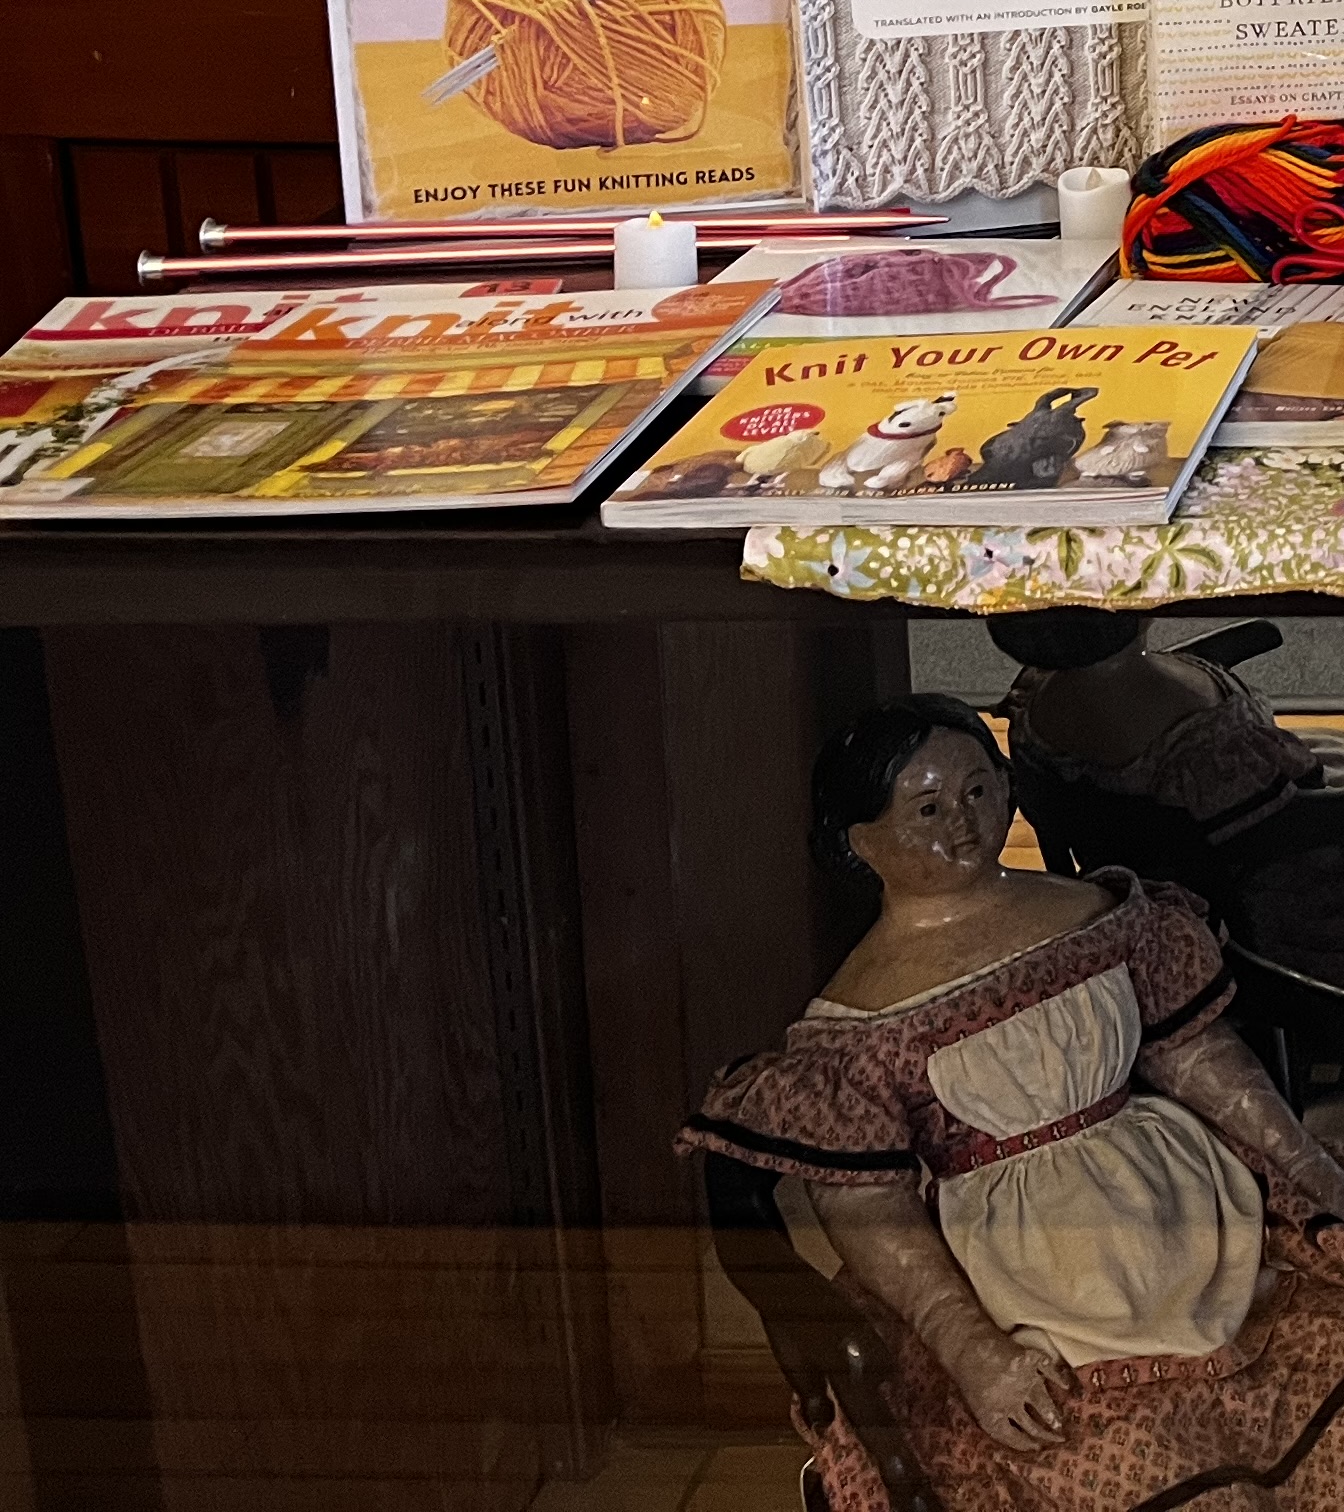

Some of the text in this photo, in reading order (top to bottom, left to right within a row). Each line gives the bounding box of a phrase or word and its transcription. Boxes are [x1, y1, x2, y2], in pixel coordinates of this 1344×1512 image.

[874, 15, 943, 27] TRANSLATED
[945, 13, 974, 23] WITH
[976, 12, 991, 20] AN
[993, 7, 1072, 20] INTRODUCTION
[1075, 6, 1088, 14] BY
[1091, 4, 1124, 14] GAYLE
[1230, 94, 1276, 105] ESSAYS
[1280, 93, 1298, 103] ON
[413, 167, 756, 204] ENJOY THESE FUN KNITTING READS
[456, 309, 644, 328] along with
[1127, 304, 1296, 313] ENGLAND
[765, 352, 869, 386] Knit
[891, 343, 1003, 369] Your
[1017, 335, 1125, 364] Own
[1133, 340, 1220, 370] Pet
